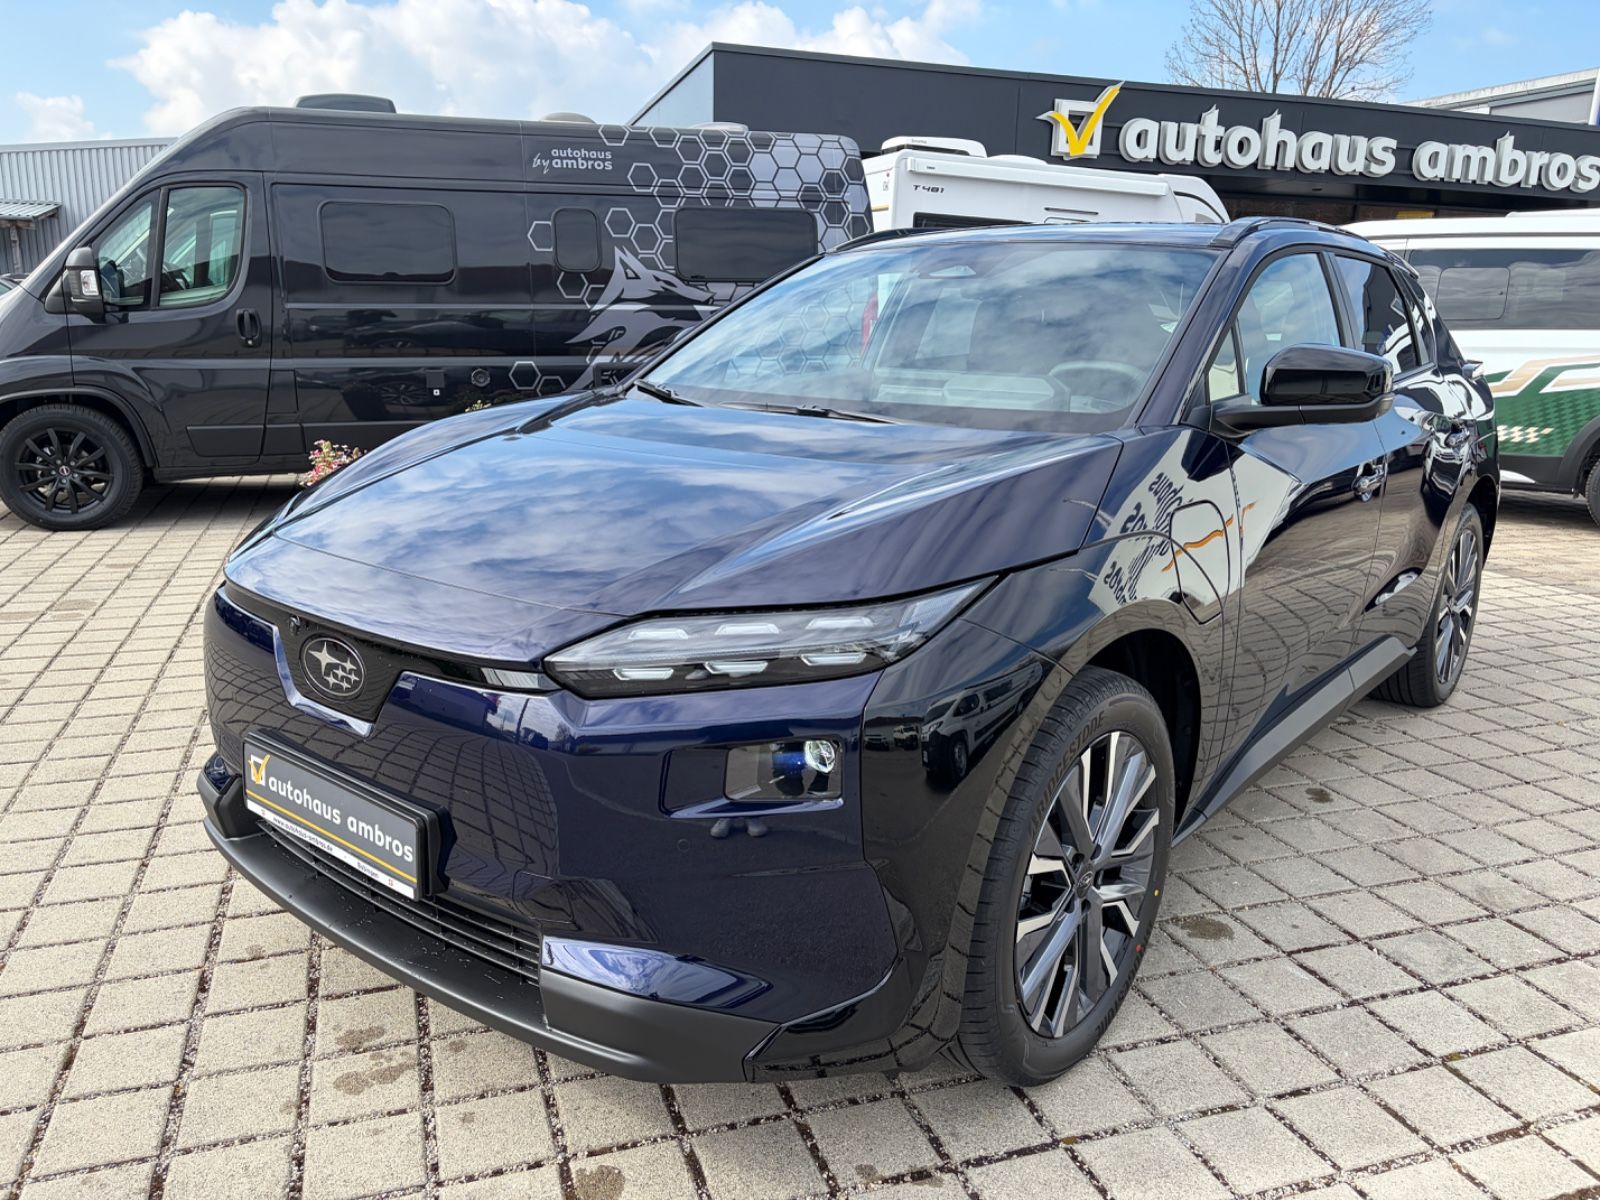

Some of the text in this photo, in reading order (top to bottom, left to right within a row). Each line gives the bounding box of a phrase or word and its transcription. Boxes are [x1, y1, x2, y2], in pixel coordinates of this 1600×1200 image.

[532, 152, 613, 174] by ambros
[551, 147, 612, 159] autohaus
[1119, 104, 1600, 193] autohaus ambros
[268, 776, 414, 863] autohaus ambros
